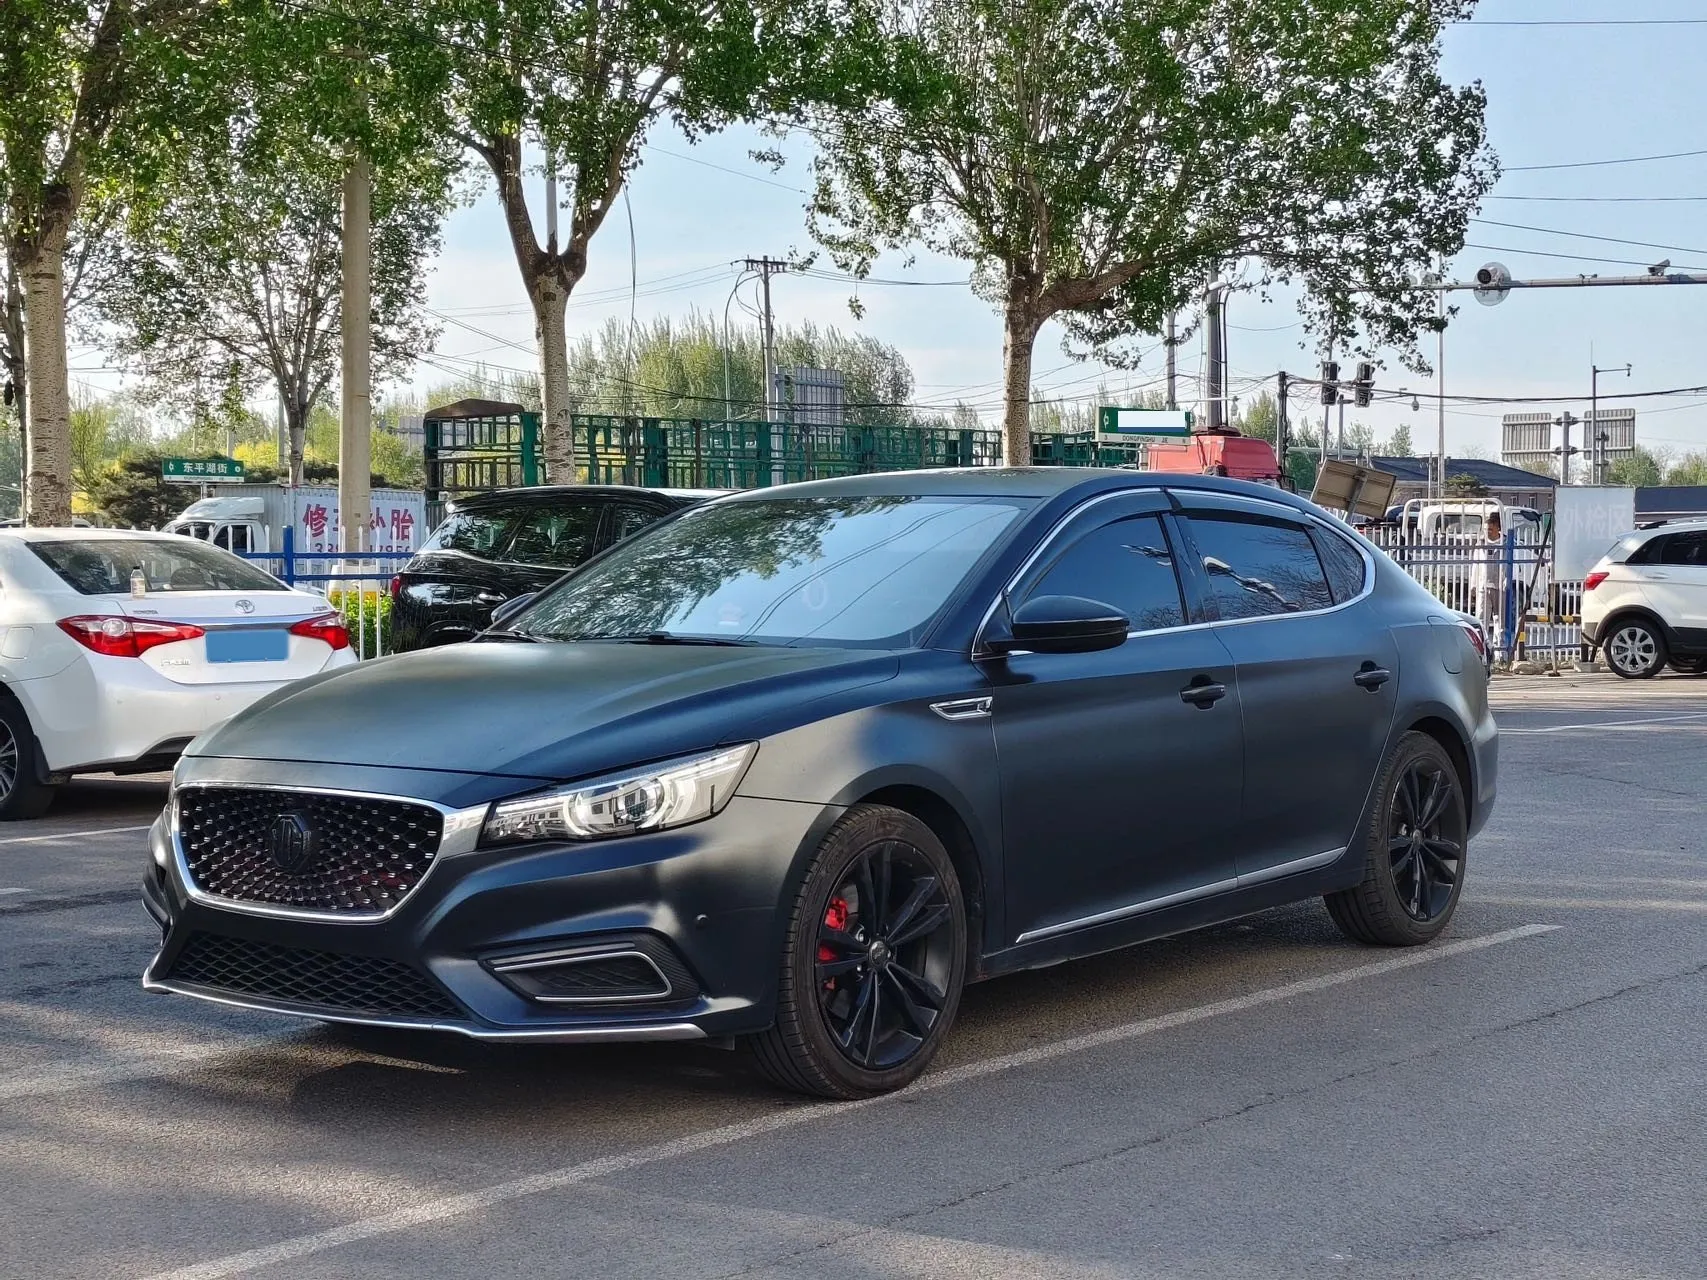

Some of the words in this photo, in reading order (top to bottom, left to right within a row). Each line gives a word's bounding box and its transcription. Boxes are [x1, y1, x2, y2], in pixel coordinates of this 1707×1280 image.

[183, 462, 227, 474] 东平湖街
[303, 504, 414, 540] 修补胎
